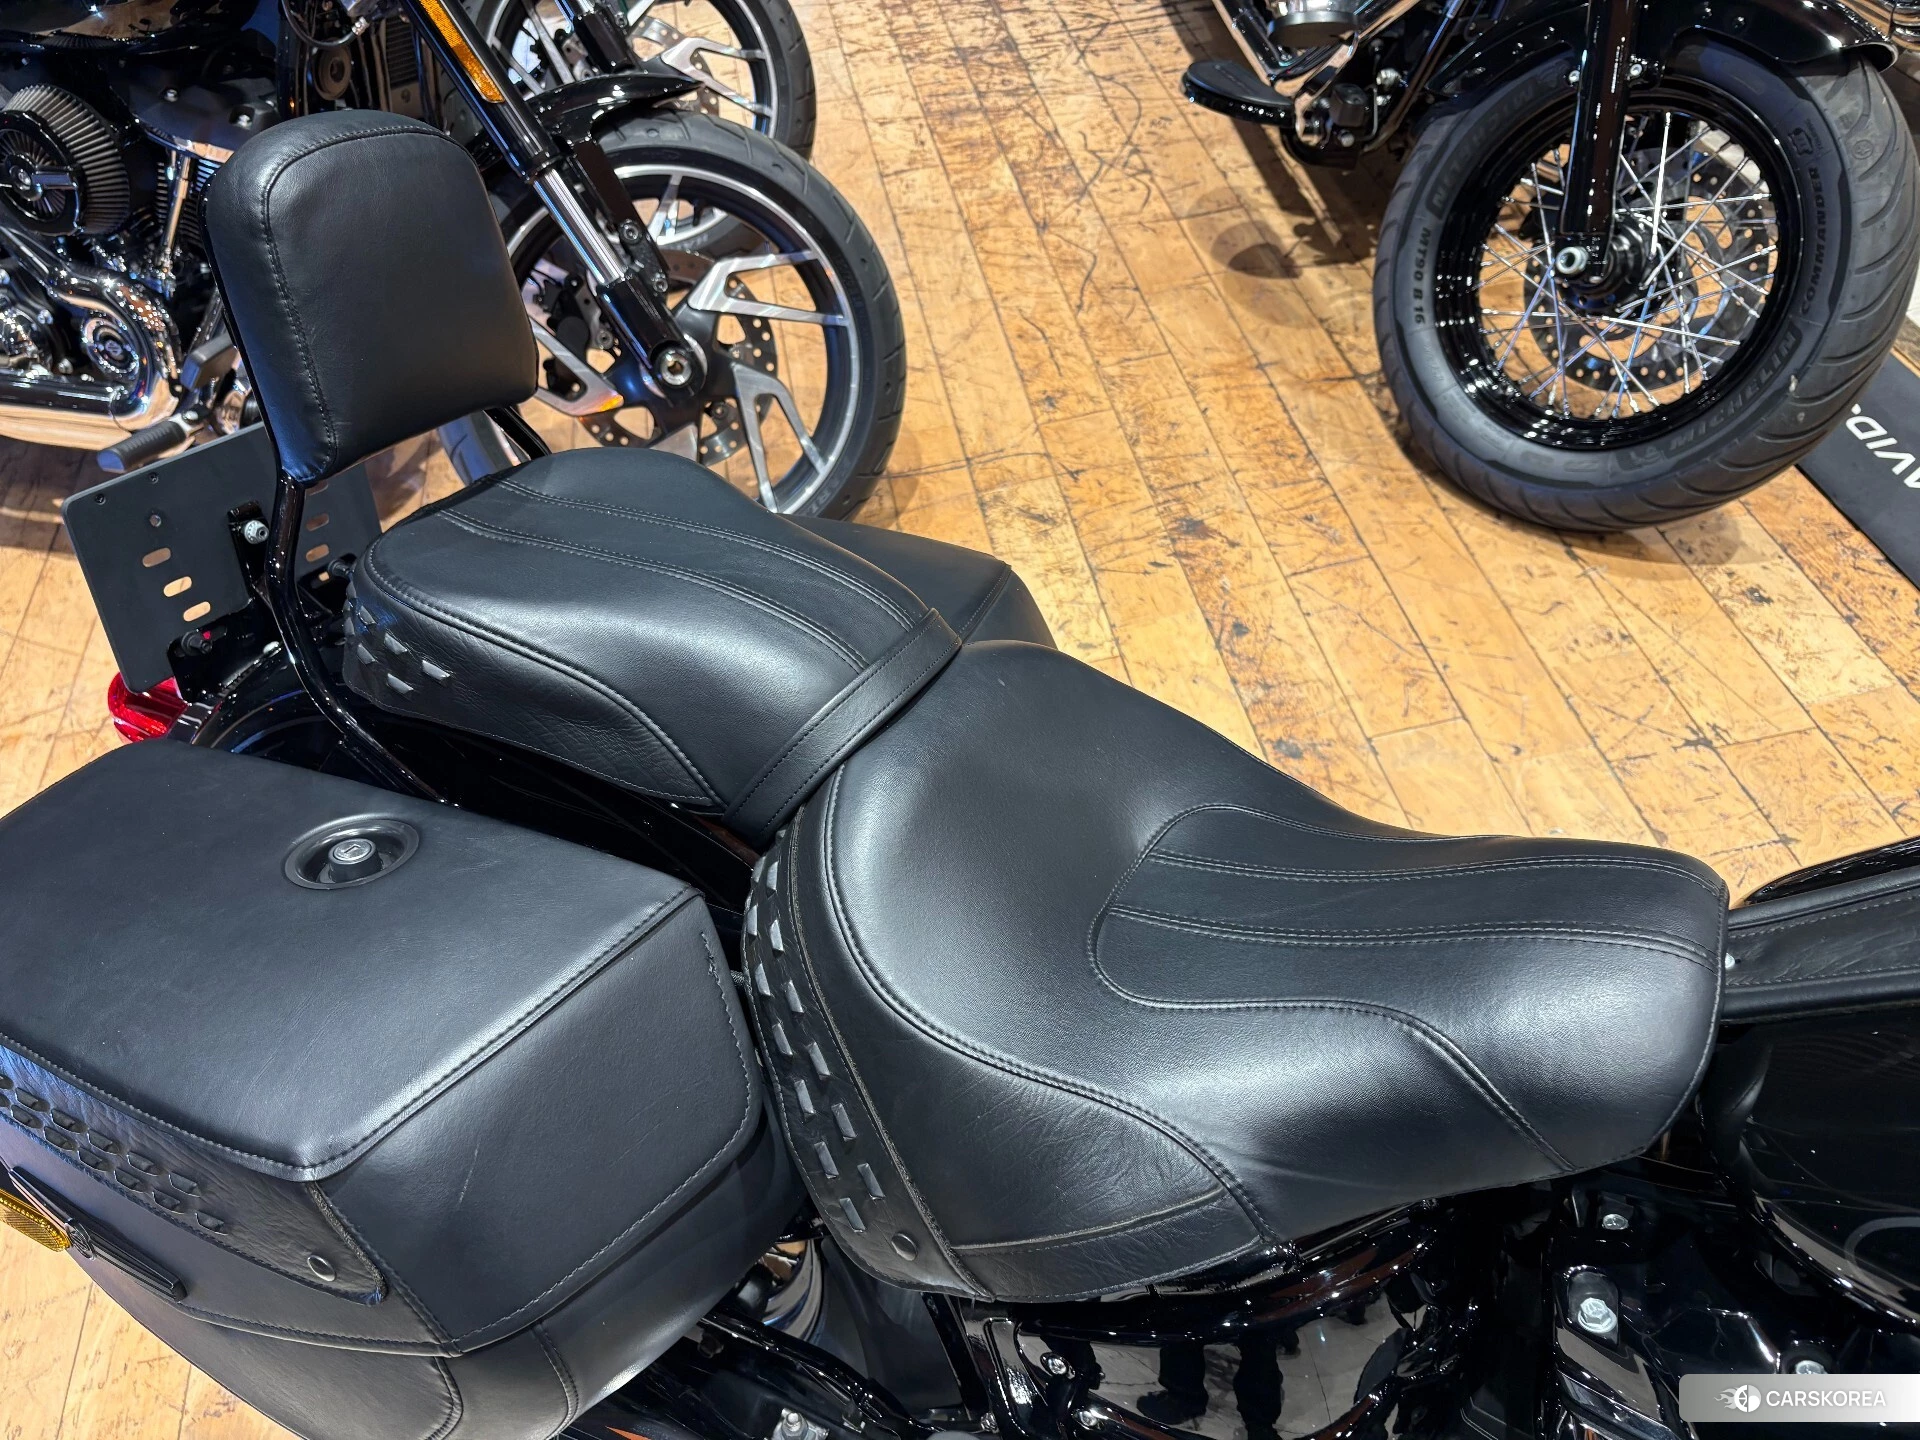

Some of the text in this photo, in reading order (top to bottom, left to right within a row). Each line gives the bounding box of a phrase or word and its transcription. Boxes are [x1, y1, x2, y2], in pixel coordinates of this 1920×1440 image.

[1414, 227, 1431, 281] MT90
[1801, 167, 1826, 315] COMMANDER
[1669, 331, 1796, 450] MICHELIN
[1845, 403, 1920, 489] VID
